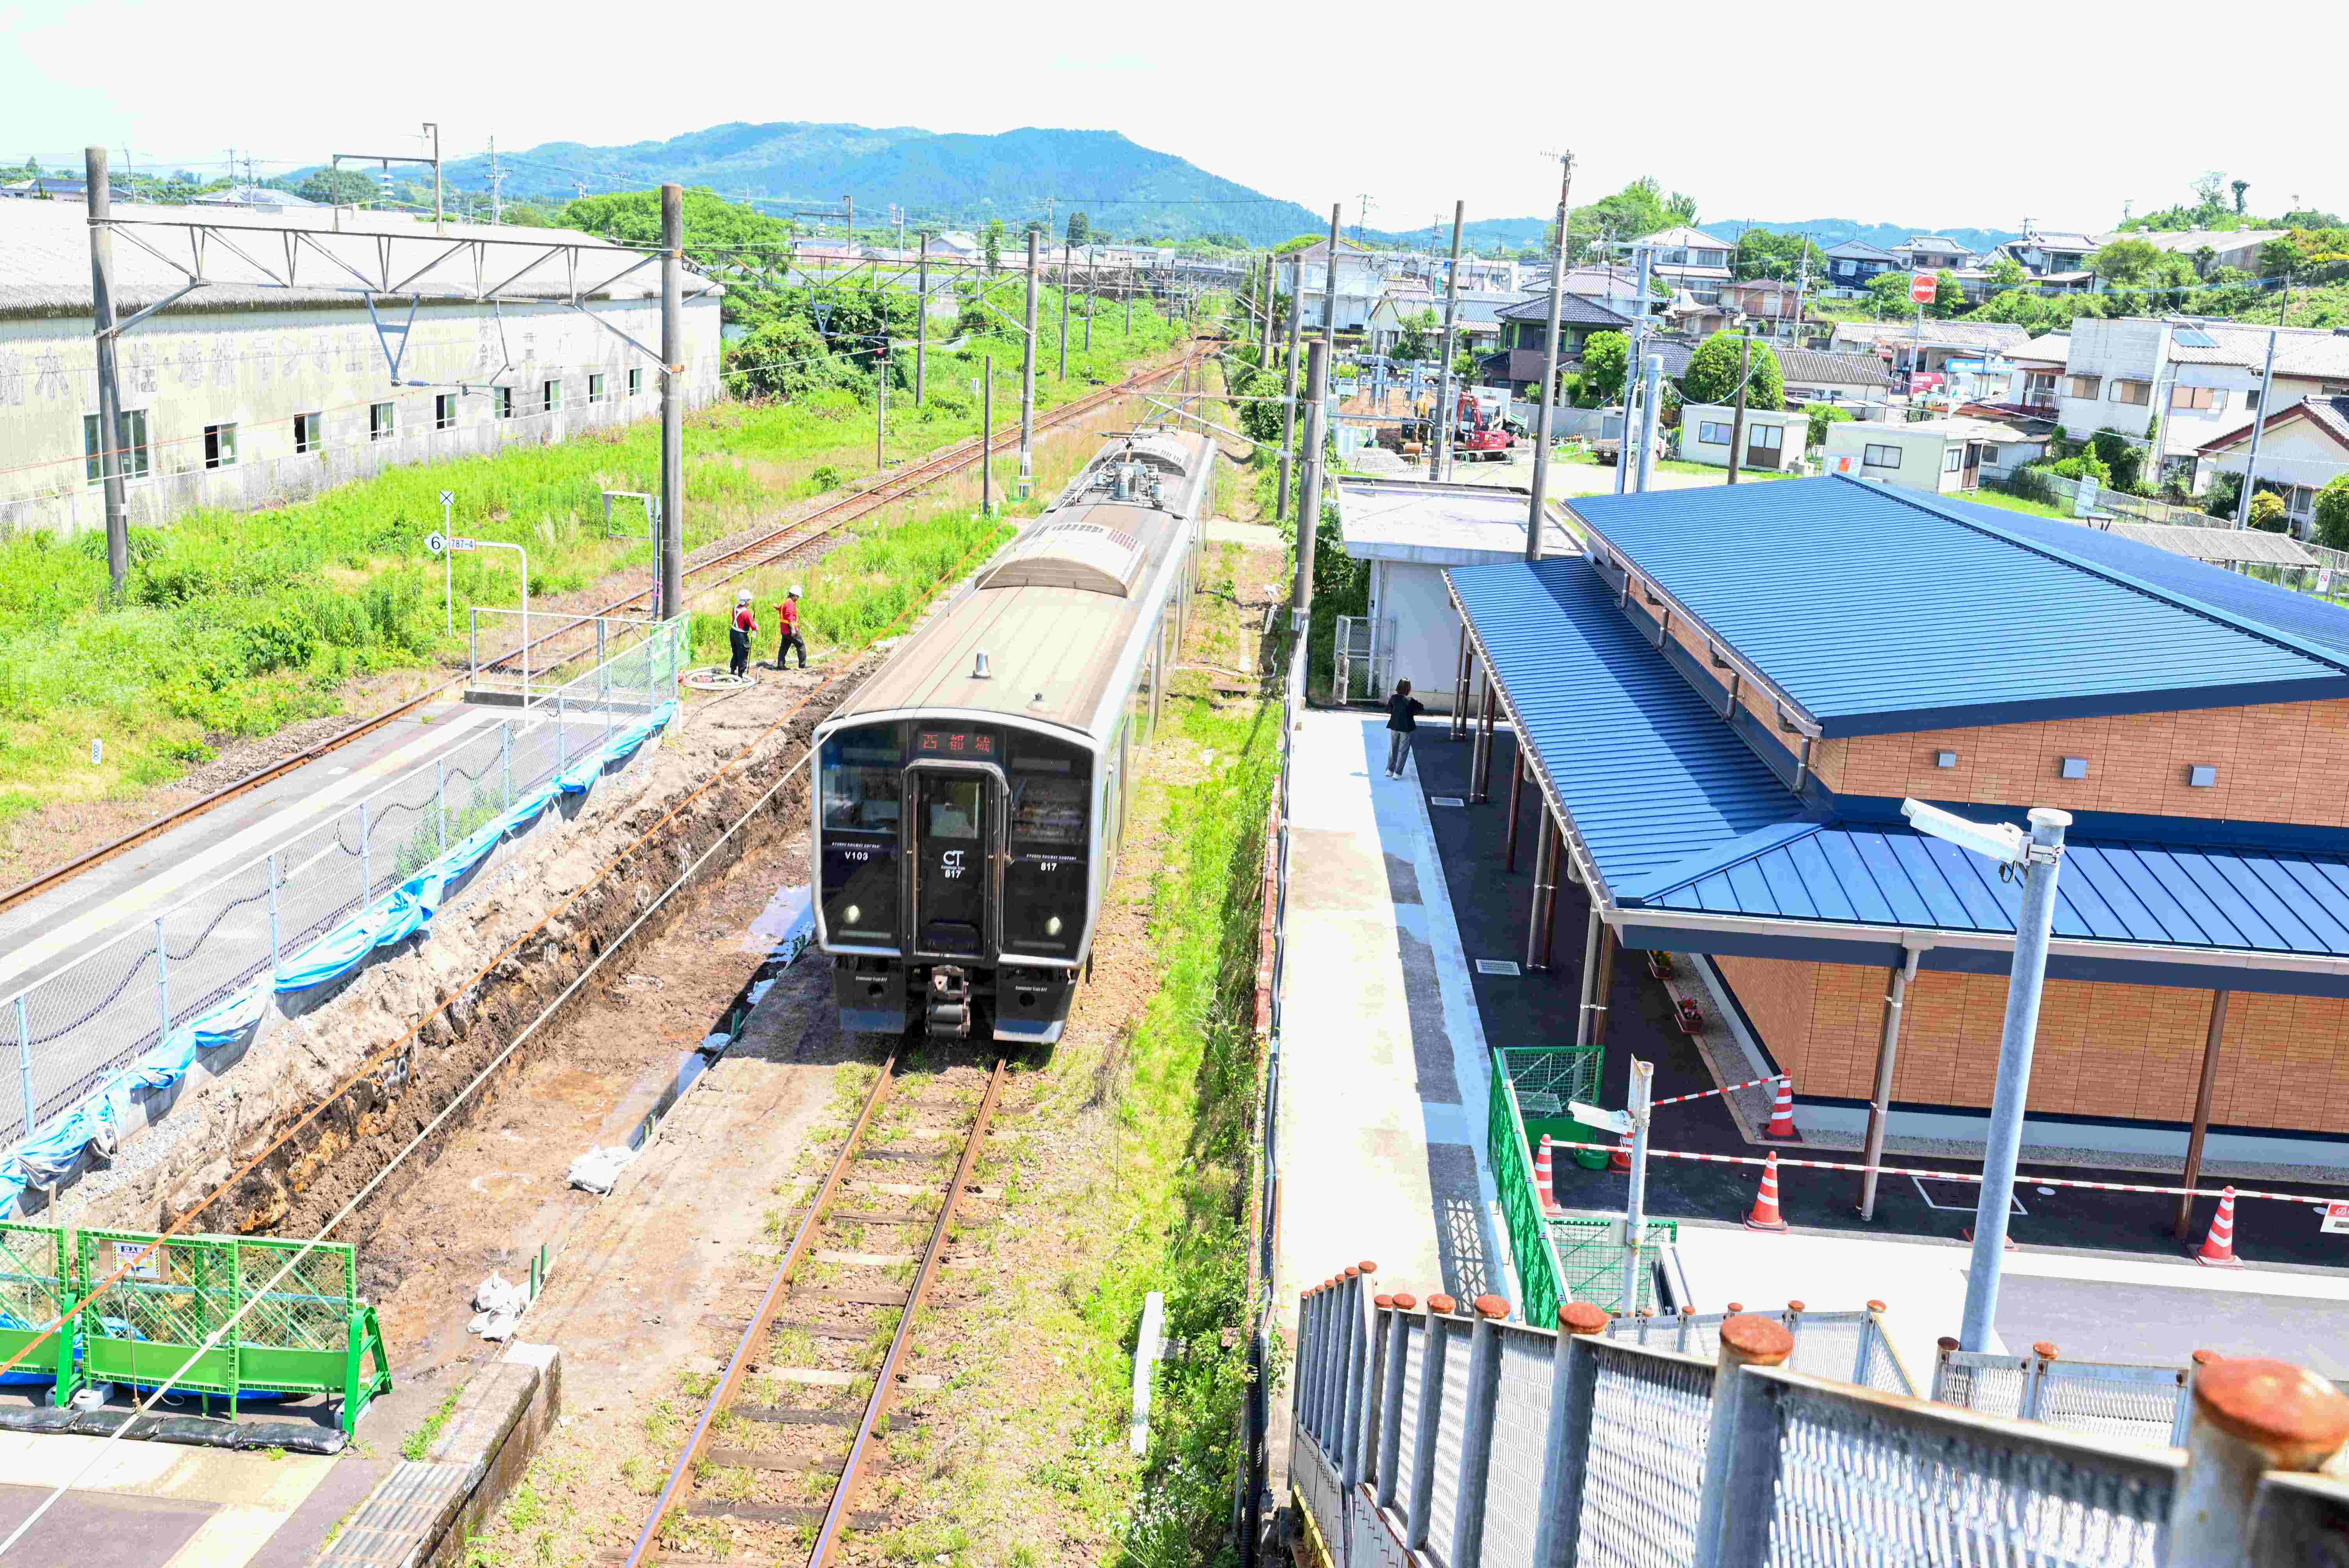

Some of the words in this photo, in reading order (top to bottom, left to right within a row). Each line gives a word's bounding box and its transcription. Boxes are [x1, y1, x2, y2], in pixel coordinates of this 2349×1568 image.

[431, 536, 440, 549] 6
[451, 540, 473, 549] 787-4
[919, 734, 991, 753] 西都城
[943, 850, 964, 866] CT
[1041, 862, 1057, 871] 817
[945, 869, 961, 878] 817
